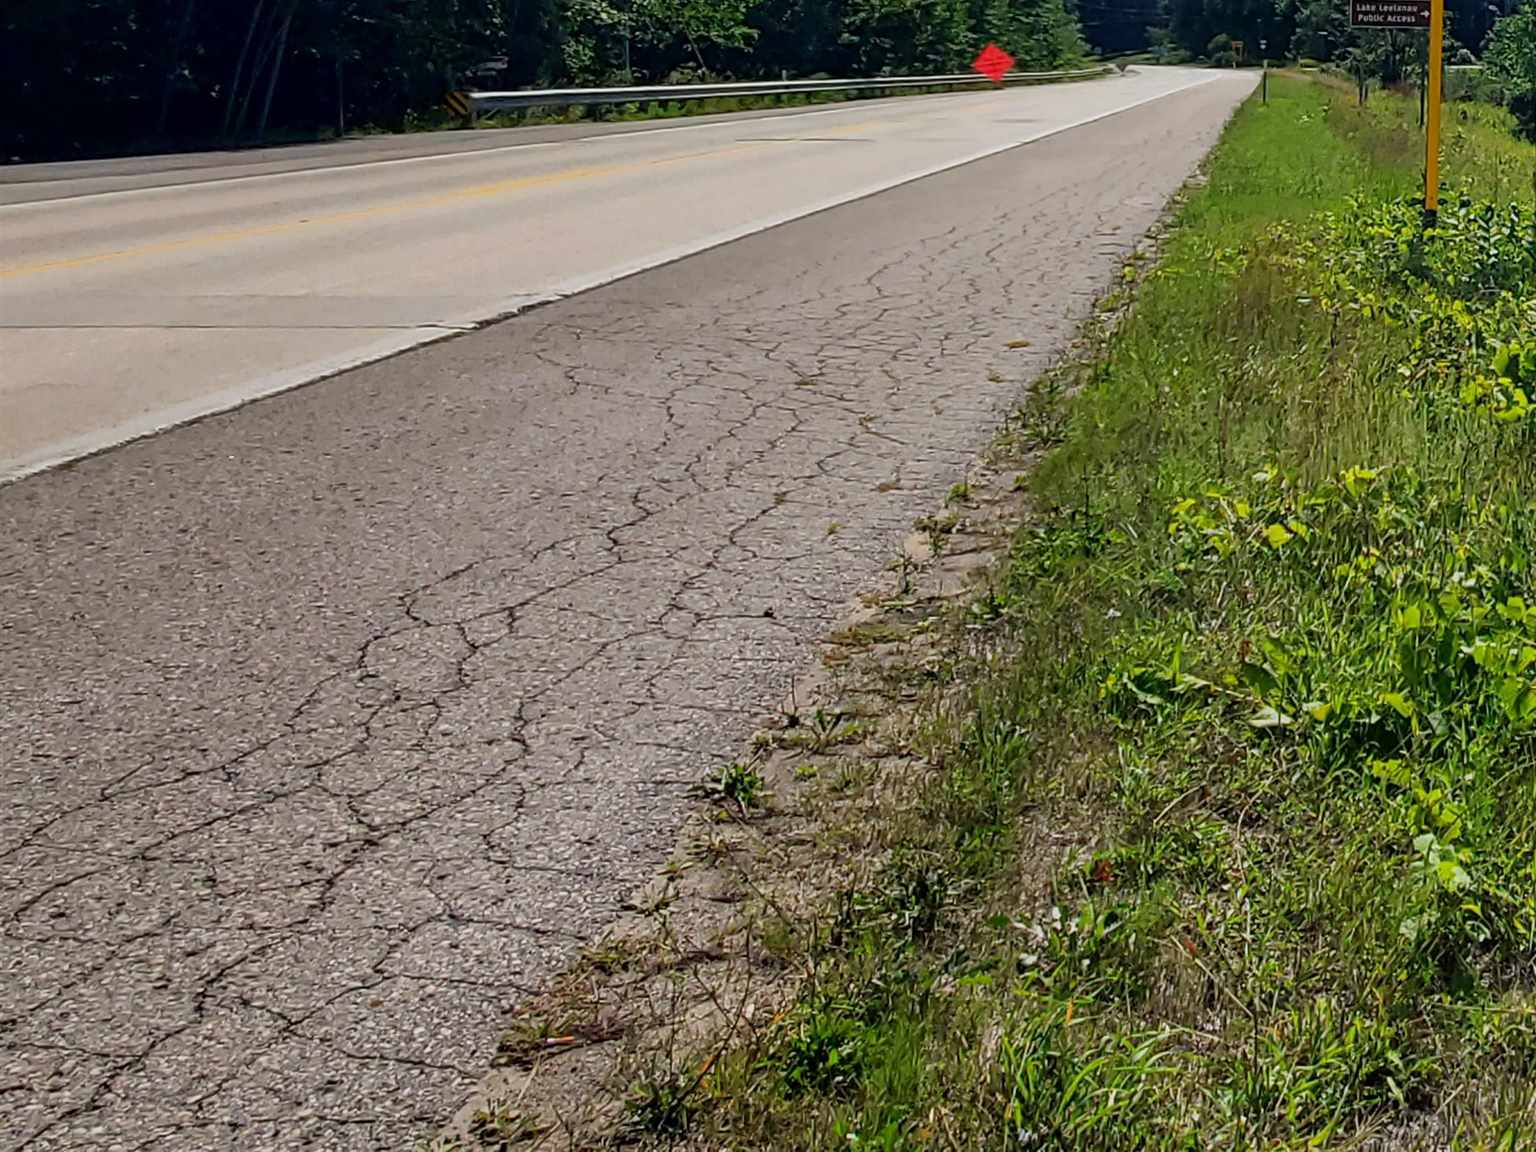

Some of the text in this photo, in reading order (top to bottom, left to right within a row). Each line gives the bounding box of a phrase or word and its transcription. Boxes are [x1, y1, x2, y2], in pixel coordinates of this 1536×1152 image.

[1356, 3, 1377, 12] Lake
[1358, 14, 1416, 23] Public Access
